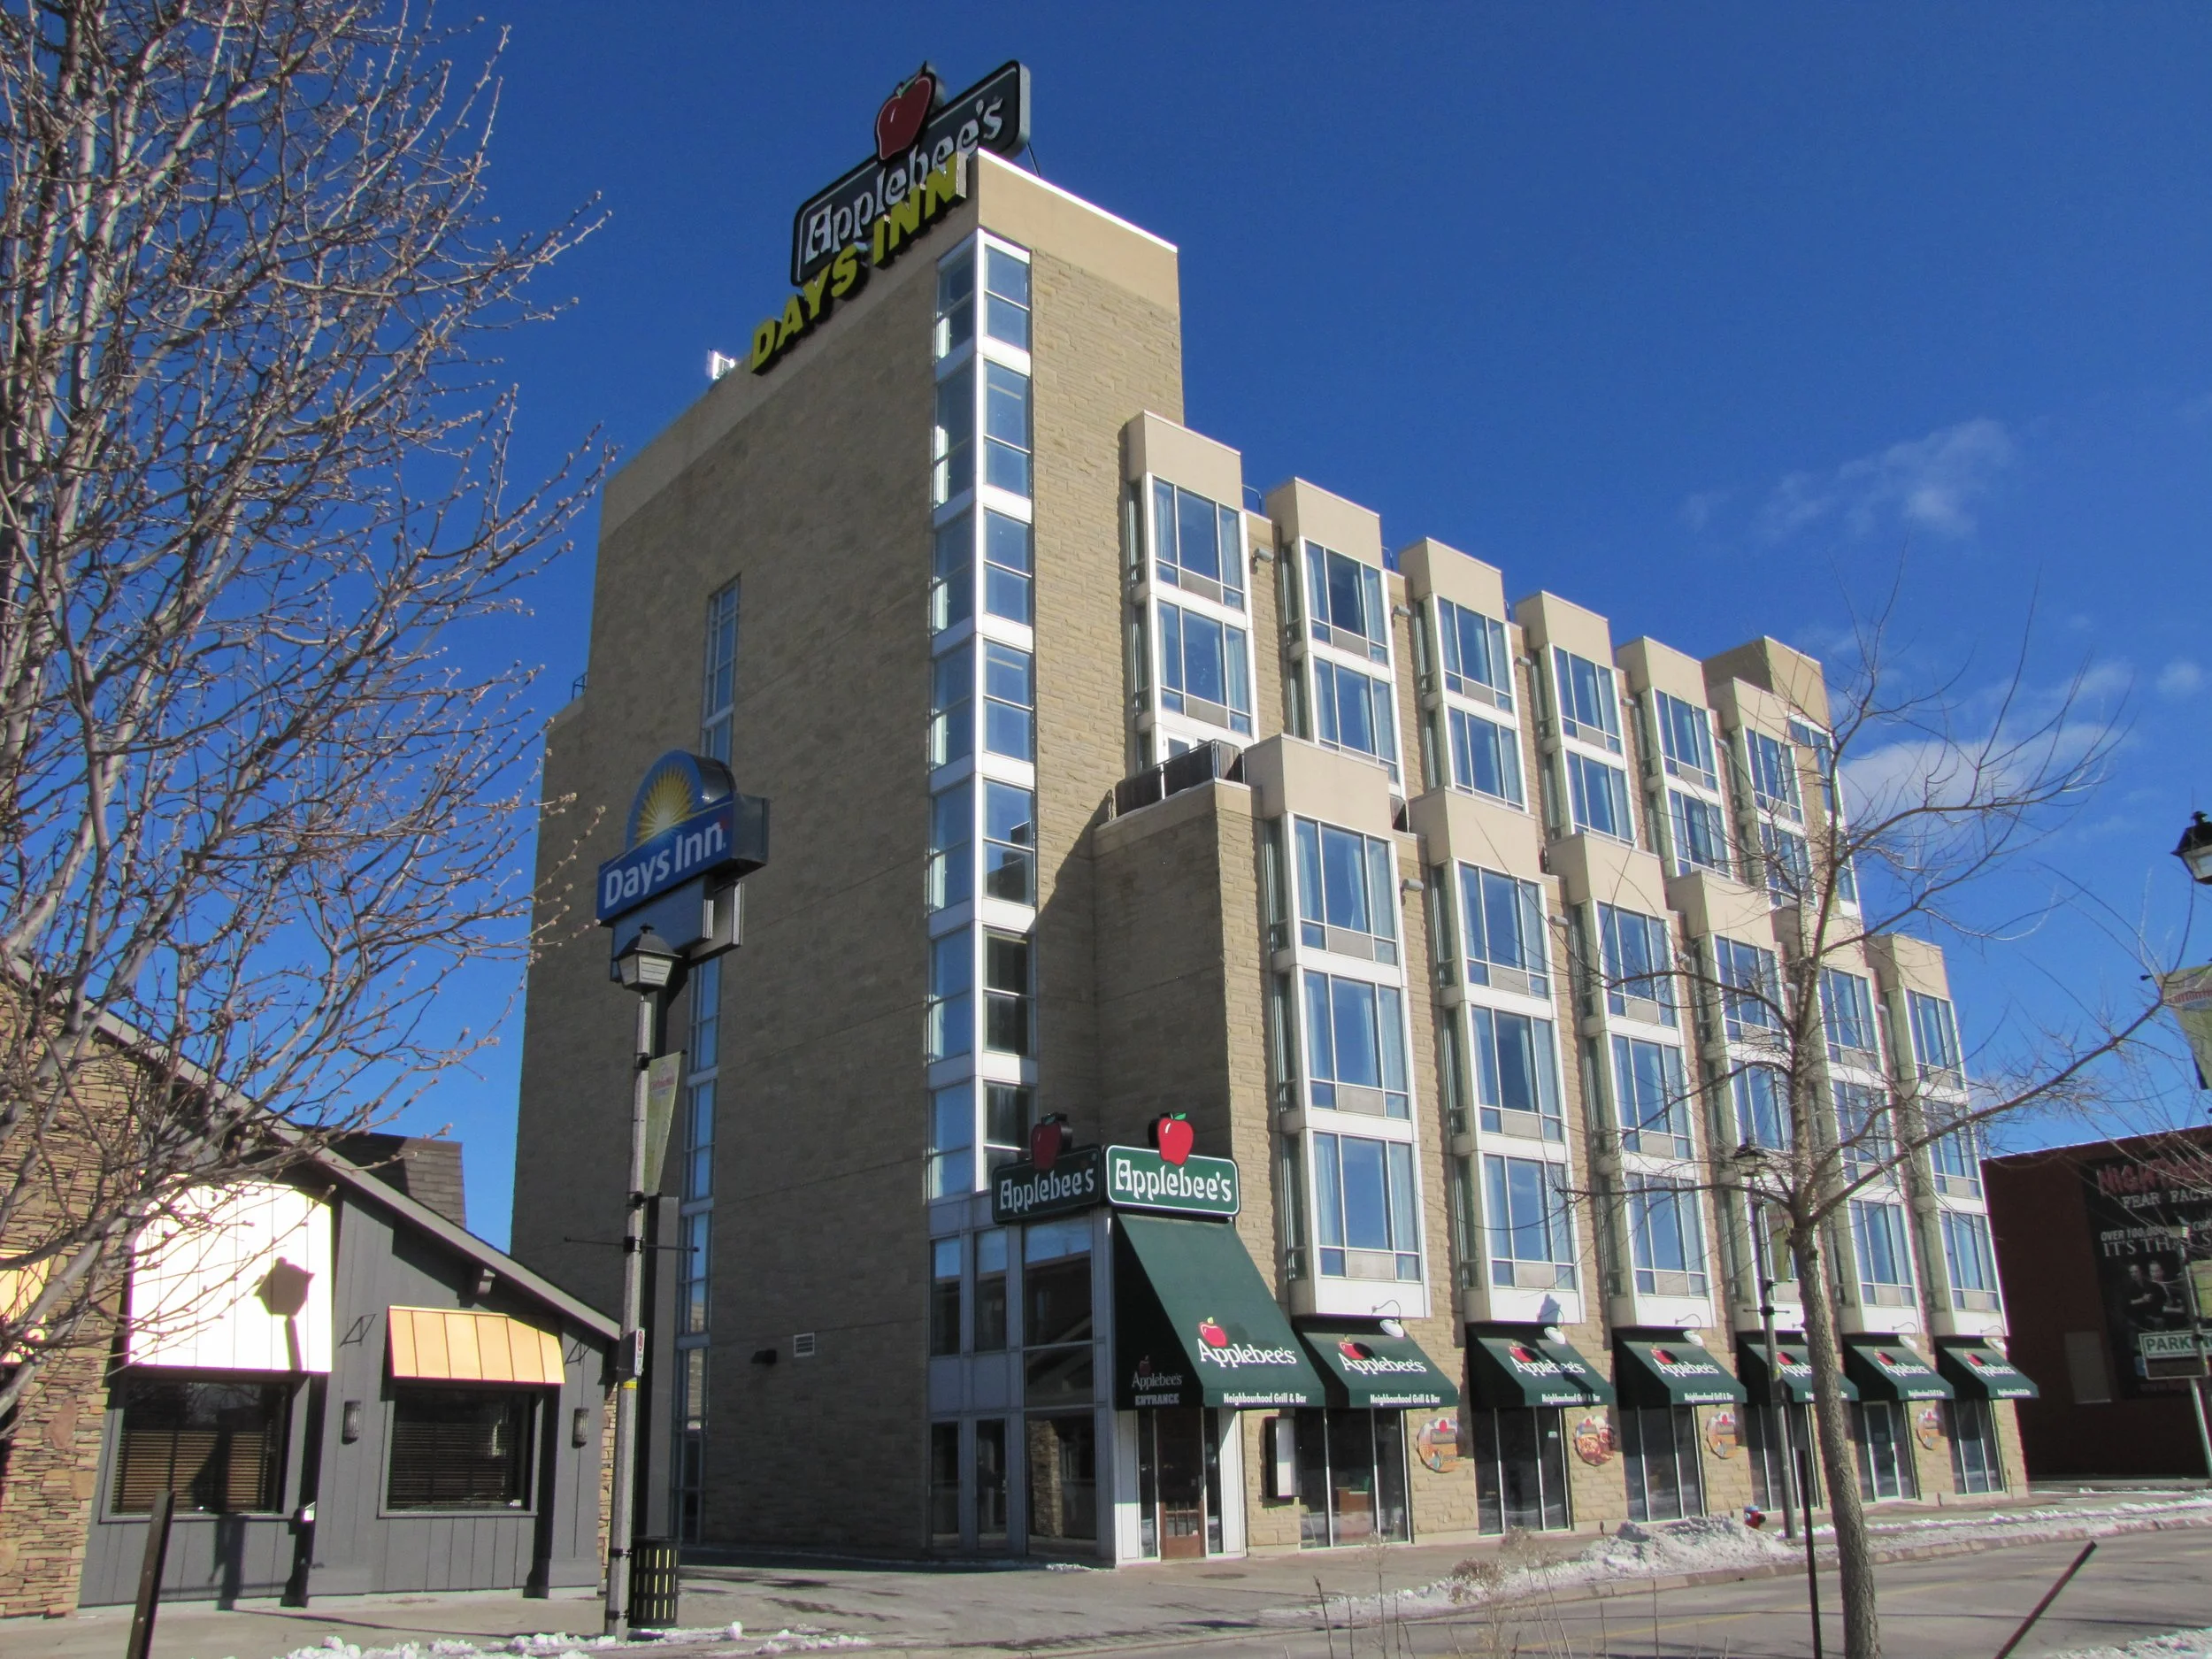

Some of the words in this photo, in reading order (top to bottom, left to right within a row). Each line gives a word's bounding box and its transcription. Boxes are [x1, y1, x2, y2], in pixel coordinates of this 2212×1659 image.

[804, 96, 1004, 264] Applebee's
[750, 242, 859, 374] DAYS
[872, 150, 958, 265] INN
[604, 849, 671, 910] Days
[674, 821, 726, 872] Inn
[1115, 1157, 1233, 1202] Applebee's
[2122, 1192, 2161, 1209] FEAR
[1197, 1338, 1297, 1367] Applebee's
[1338, 1352, 1427, 1375] Applebee's
[1654, 1356, 1719, 1377] Applebee's
[1131, 1370, 1183, 1391] Applebee's
[1135, 1393, 1180, 1407] ENTRANCE
[1224, 1392, 1271, 1405] Neighbourhood
[1273, 1392, 1287, 1404] Grill
[1289, 1393, 1294, 1403] &
[1296, 1393, 1307, 1404] Bar
[1371, 1394, 1410, 1405] Neighbourhood
[1411, 1394, 1424, 1404] Grill
[1431, 1394, 1440, 1404] Bar
